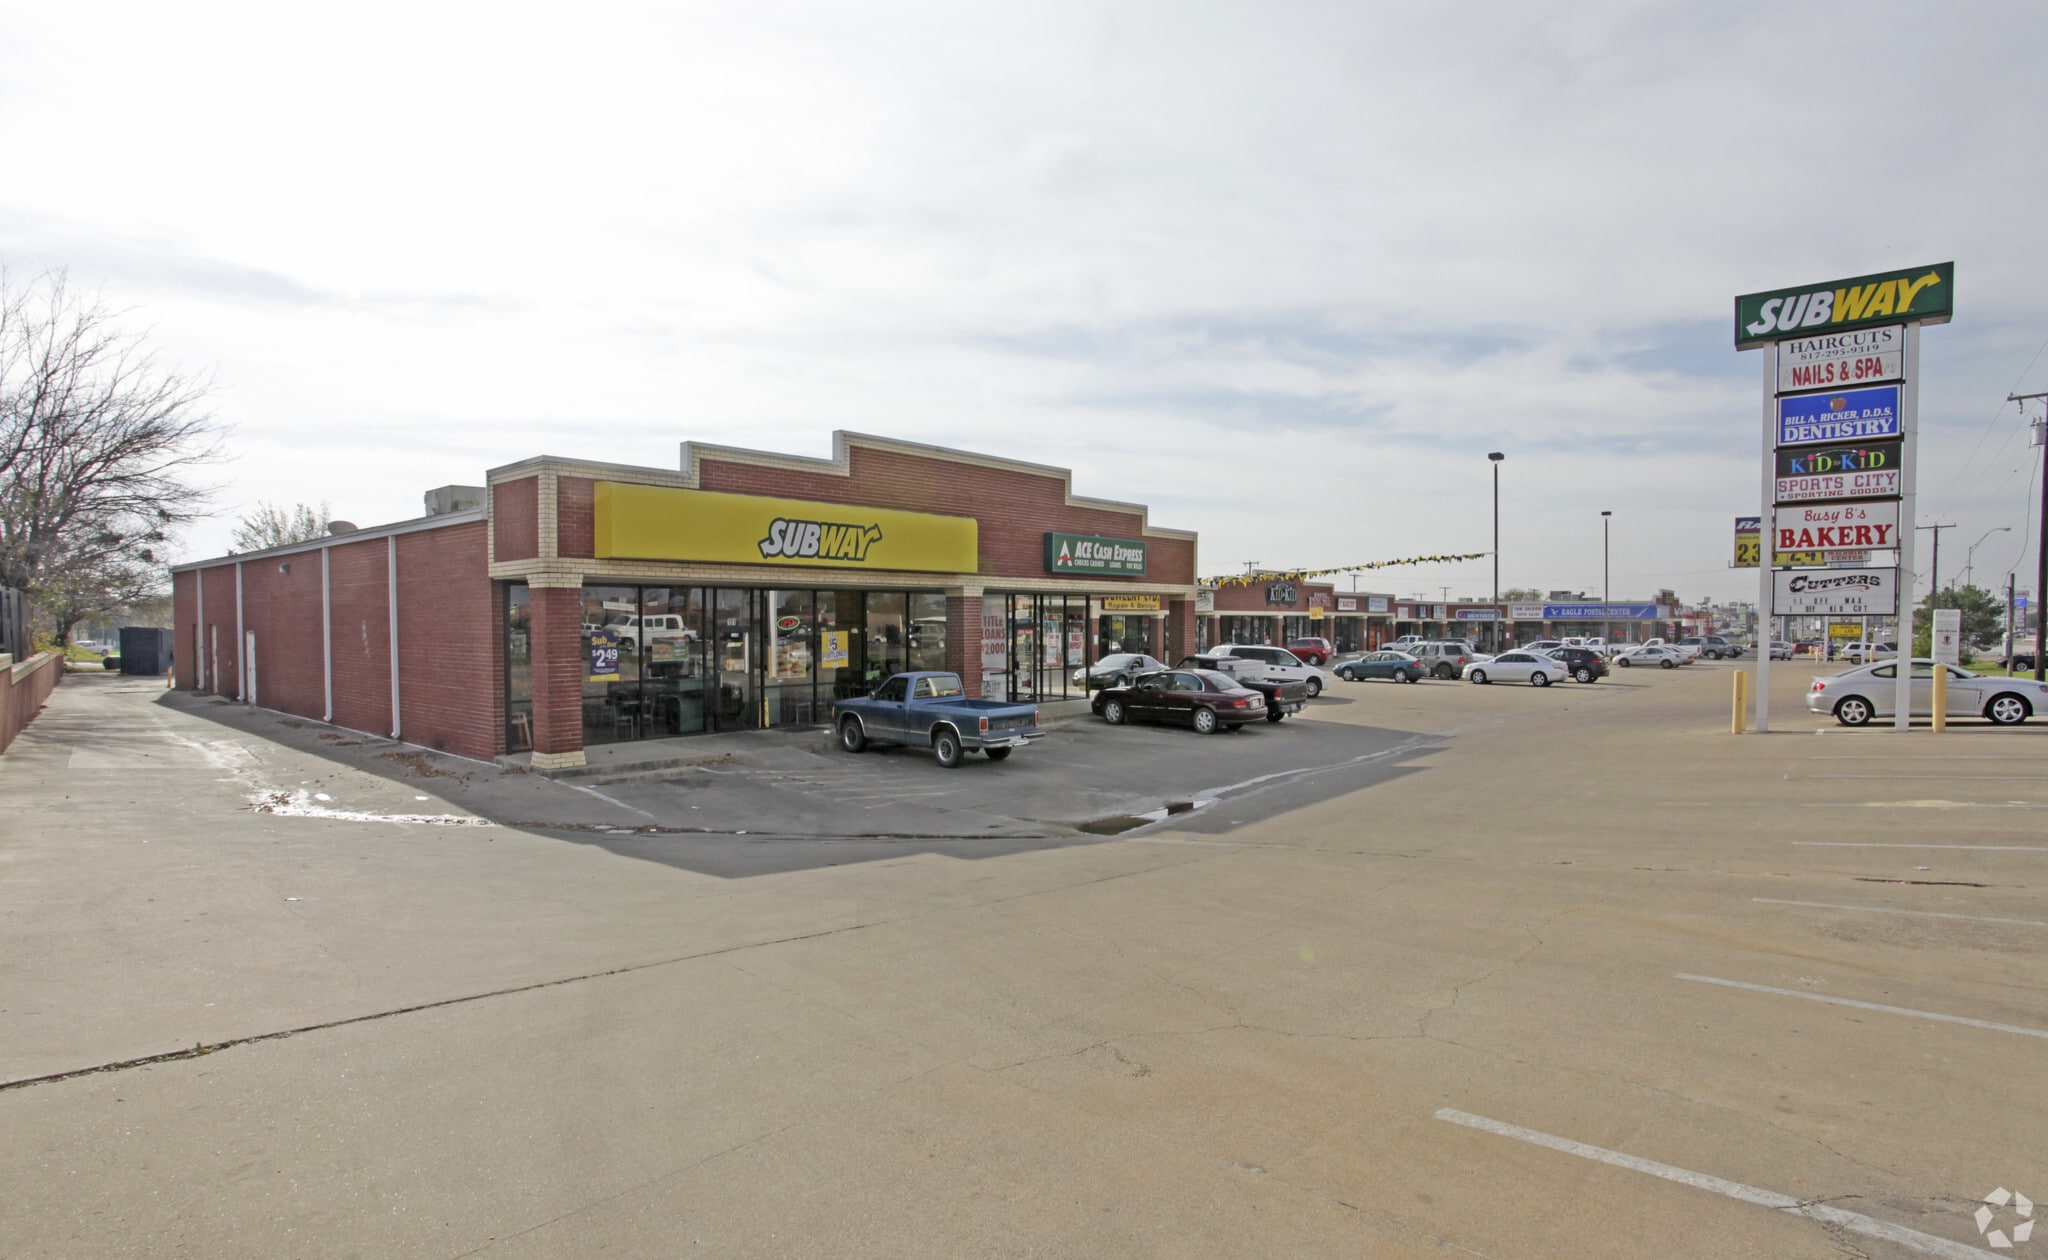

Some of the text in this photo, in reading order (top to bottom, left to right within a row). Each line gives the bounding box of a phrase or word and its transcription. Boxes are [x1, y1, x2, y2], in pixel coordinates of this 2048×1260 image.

[1746, 271, 1941, 337] SUBWAY
[1790, 329, 1893, 354] HAIRCUTS
[1800, 344, 1880, 361] 817-295-9319
[1792, 362, 1835, 387] NAILS
[1839, 360, 1850, 381] &
[1855, 356, 1883, 379] SPA
[1784, 407, 1893, 426] BILL A. RICKER, D.D.S.
[1784, 418, 1894, 442] DENTISTRY
[1778, 472, 1897, 493] SPORTS CITY
[1787, 486, 1887, 500] SPORTING GOODS
[1804, 507, 1867, 523] Busy B's
[758, 517, 883, 560] SUBWAY
[1779, 523, 1893, 549] BAKERY
[1074, 541, 1093, 559] ACE
[1074, 558, 1090, 567] CHECKS
[1090, 559, 1105, 568] CASHED
[1561, 608, 1631, 616] EAGLE POSTAL CENTER
[1805, 605, 1816, 613] OFF
[1829, 605, 1844, 613] KID
[1853, 605, 1868, 613] CUT
[983, 615, 1004, 628] TITLE
[591, 636, 607, 646] Sub
